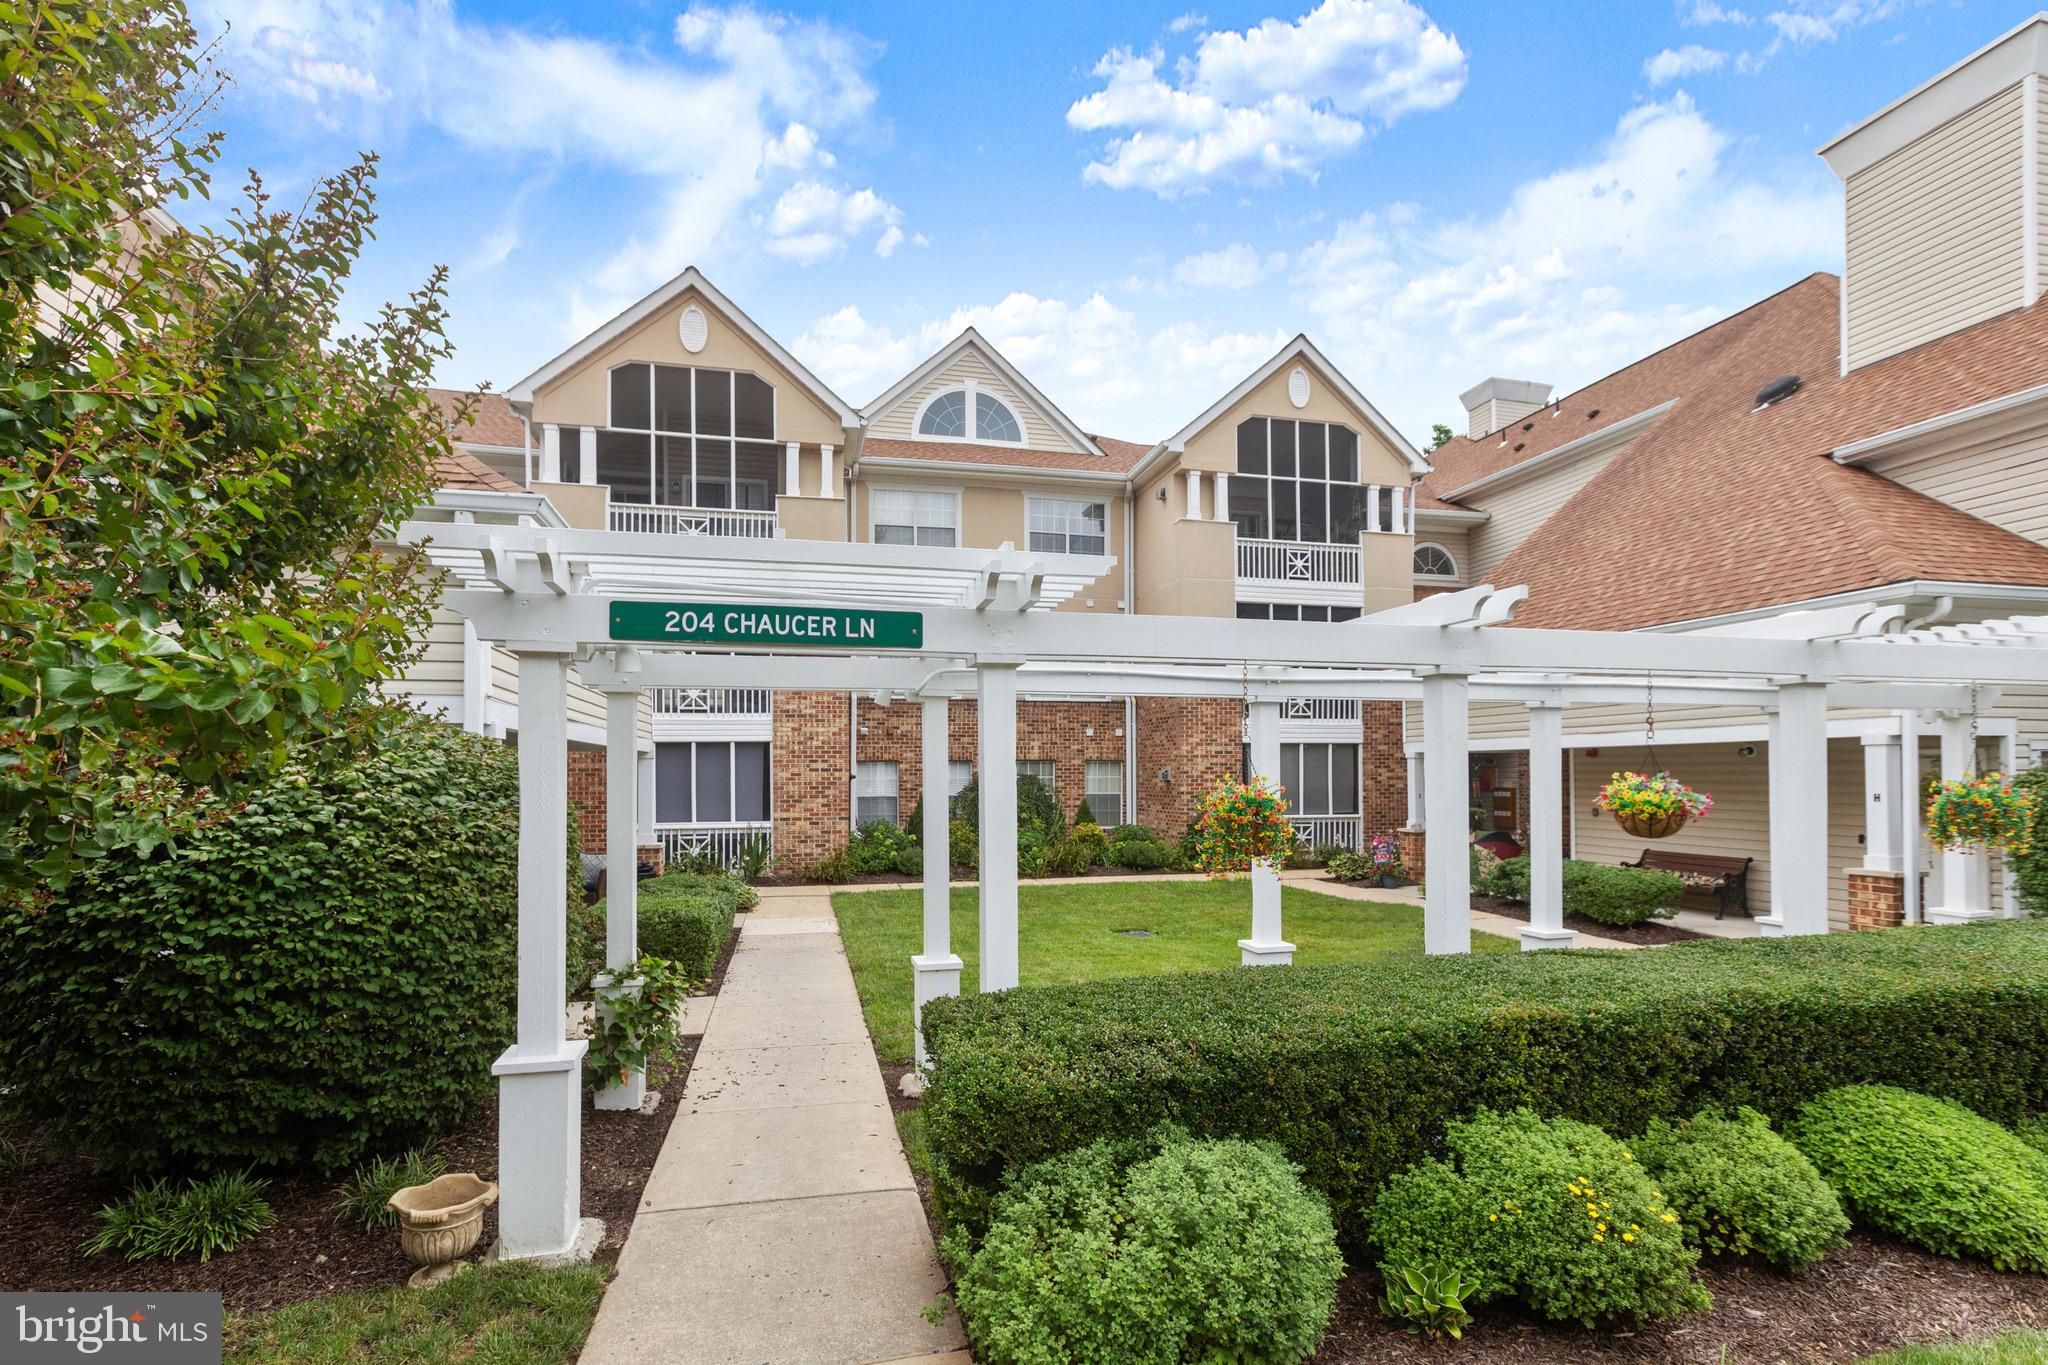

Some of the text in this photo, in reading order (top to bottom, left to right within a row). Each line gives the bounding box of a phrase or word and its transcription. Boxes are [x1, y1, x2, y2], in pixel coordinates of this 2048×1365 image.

[664, 611, 875, 638] 204 CHAUCER LN
[1873, 793, 1880, 802] H
